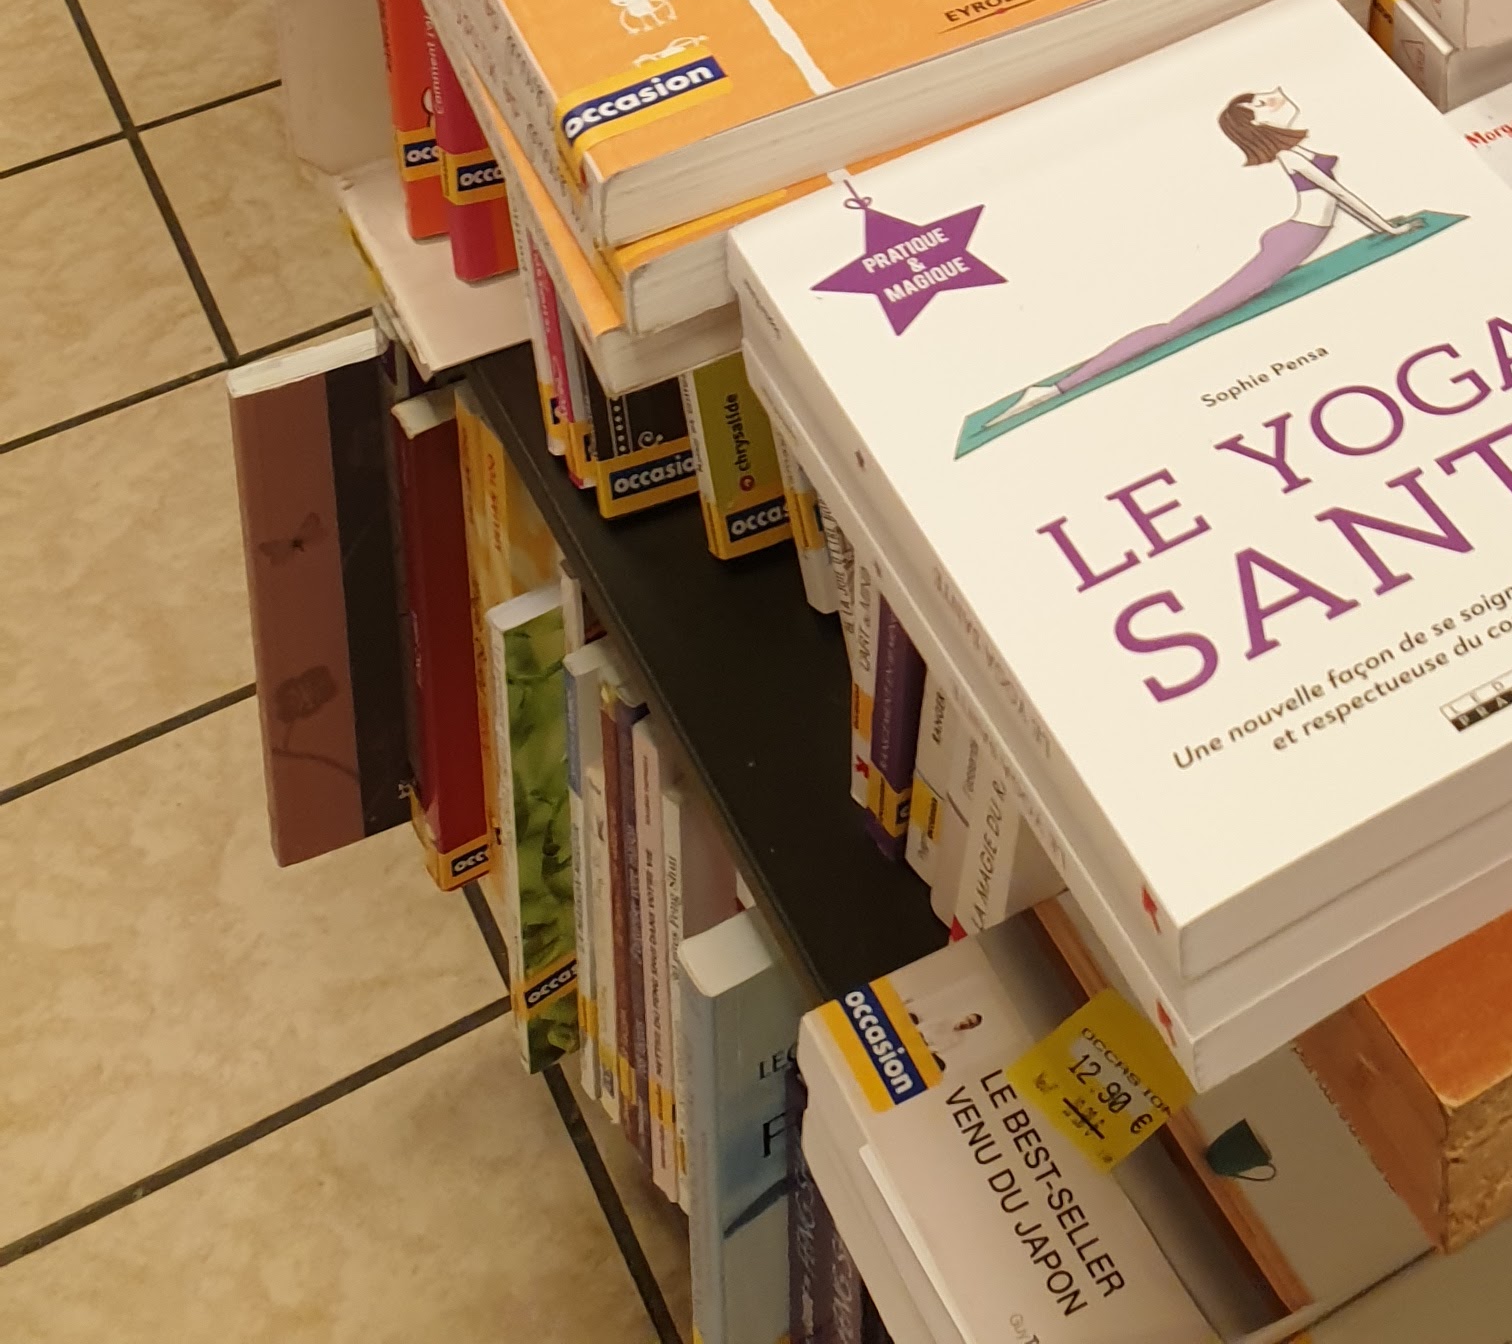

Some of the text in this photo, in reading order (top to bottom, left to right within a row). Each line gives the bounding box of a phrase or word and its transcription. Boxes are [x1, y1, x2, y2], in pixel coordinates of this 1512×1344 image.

[564, 63, 714, 137] occasion
[862, 227, 950, 275] PRATIQUE
[883, 256, 970, 304] MAGIQUE
[908, 256, 927, 273] &
[1201, 344, 1330, 408] Sophie Pensa
[728, 392, 751, 473] chrysalide
[1035, 468, 1212, 593] LE
[1171, 738, 1224, 772] Une
[1226, 678, 1325, 747] nouvelle
[1326, 644, 1396, 692] façon
[1398, 626, 1428, 654] de
[1430, 618, 1456, 640] se
[844, 990, 917, 1096] occasion
[945, 1085, 1088, 1317] VENU DU JAPON
[980, 1068, 1126, 1300] LE BEST-SELLER
